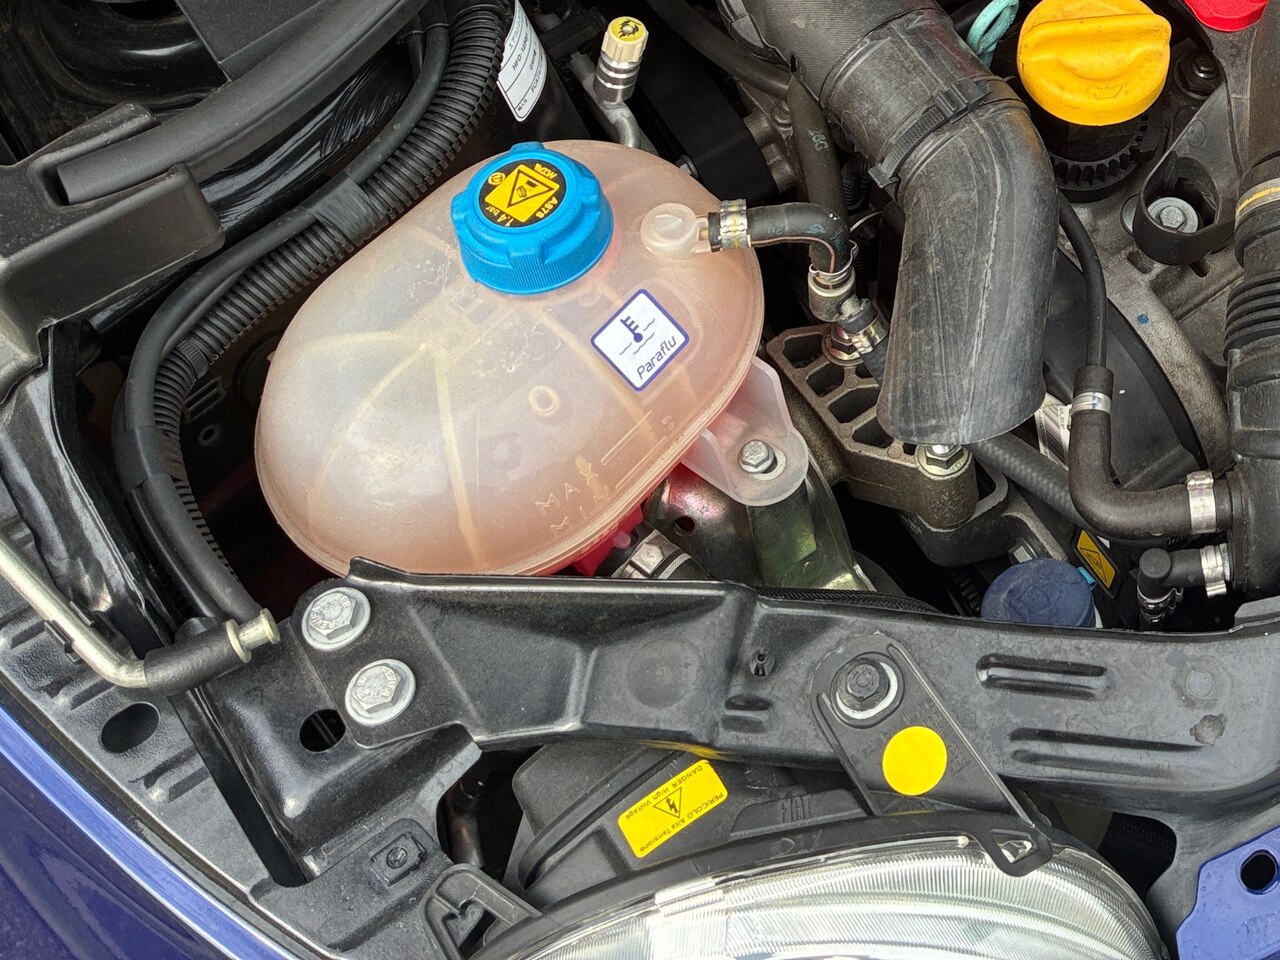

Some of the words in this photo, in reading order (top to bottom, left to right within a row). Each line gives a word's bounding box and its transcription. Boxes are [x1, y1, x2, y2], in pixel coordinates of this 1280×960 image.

[486, 206, 500, 216] bar
[497, 214, 514, 227] 1.4
[636, 336, 677, 380] Paraflu
[671, 765, 703, 788] DANGER
[652, 787, 669, 800] High
[625, 800, 652, 820] Voltage
[687, 792, 724, 819] PERICOLO
[671, 818, 686, 830] Alta
[640, 828, 671, 852] Tensione
